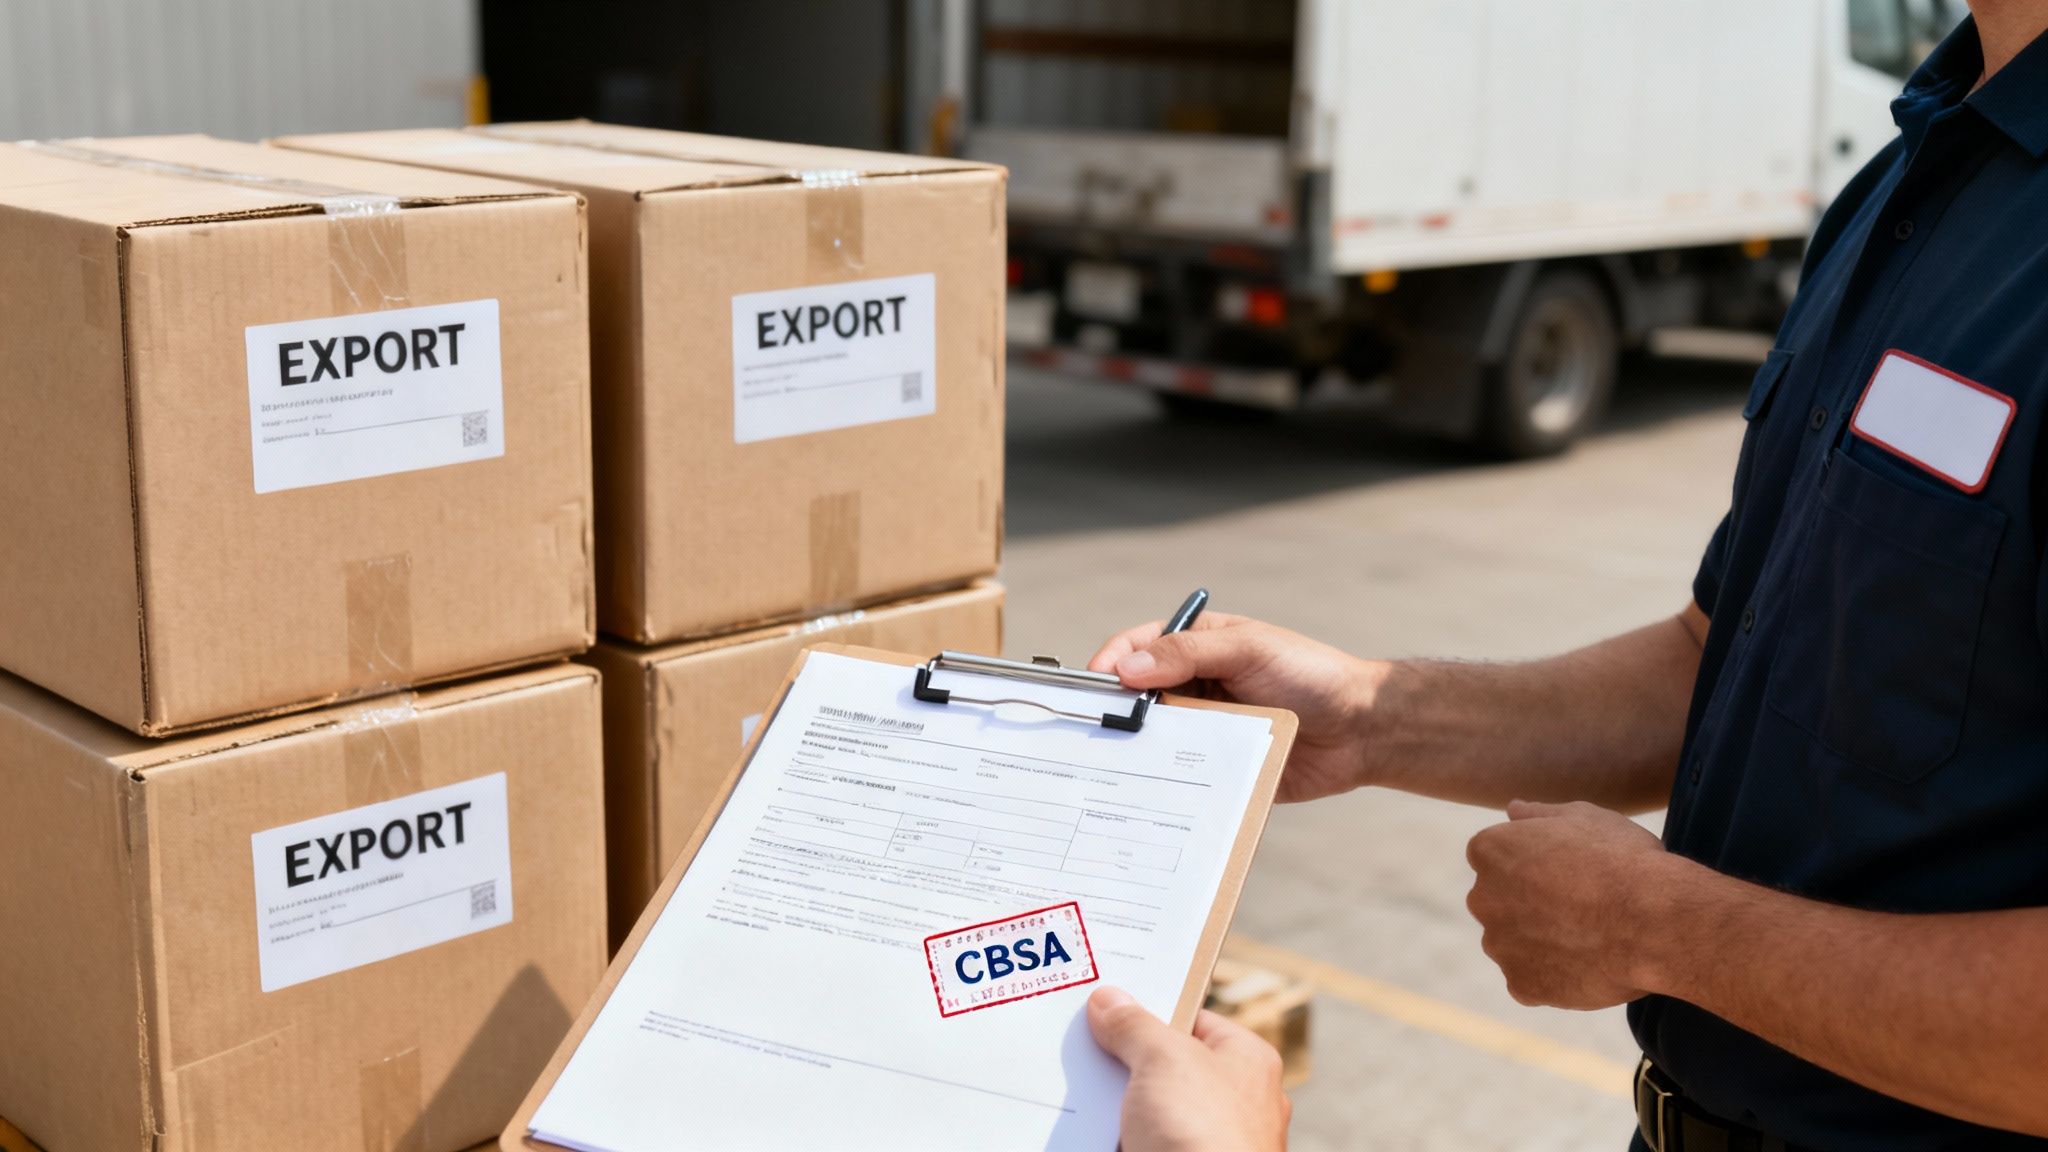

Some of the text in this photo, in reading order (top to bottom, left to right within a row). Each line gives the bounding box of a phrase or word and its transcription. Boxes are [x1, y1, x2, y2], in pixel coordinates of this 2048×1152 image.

[757, 296, 906, 350] EXPORT
[279, 323, 465, 386] EXPORT
[285, 802, 471, 888] EXPORT
[955, 931, 1072, 984] CBSA
